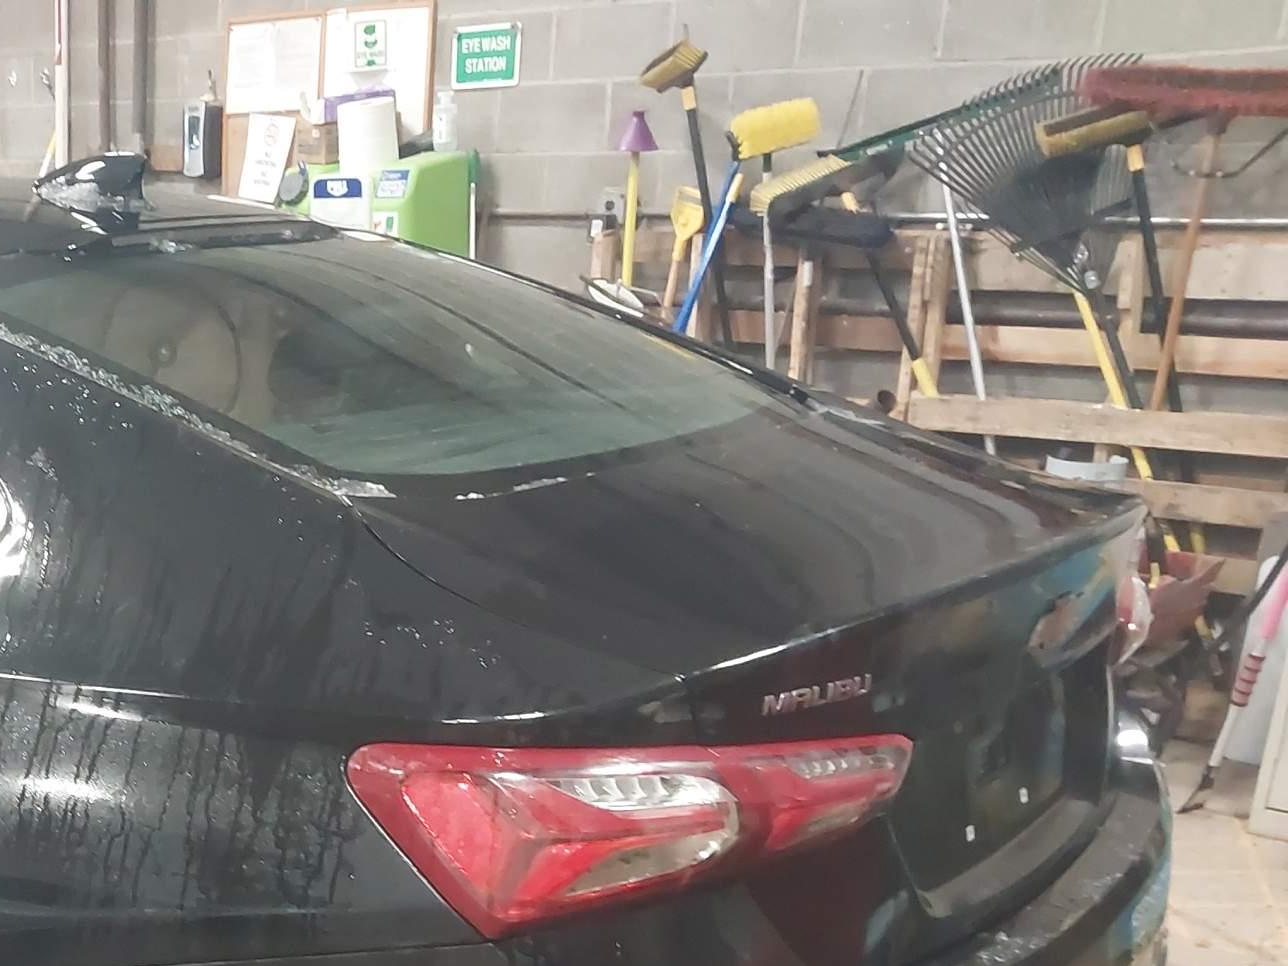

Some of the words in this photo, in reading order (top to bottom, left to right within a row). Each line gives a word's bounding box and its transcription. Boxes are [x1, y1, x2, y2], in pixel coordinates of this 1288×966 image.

[461, 37, 481, 54] EYE
[481, 34, 511, 52] WASH
[465, 55, 507, 74] STATION
[761, 673, 872, 717] MALIBU
